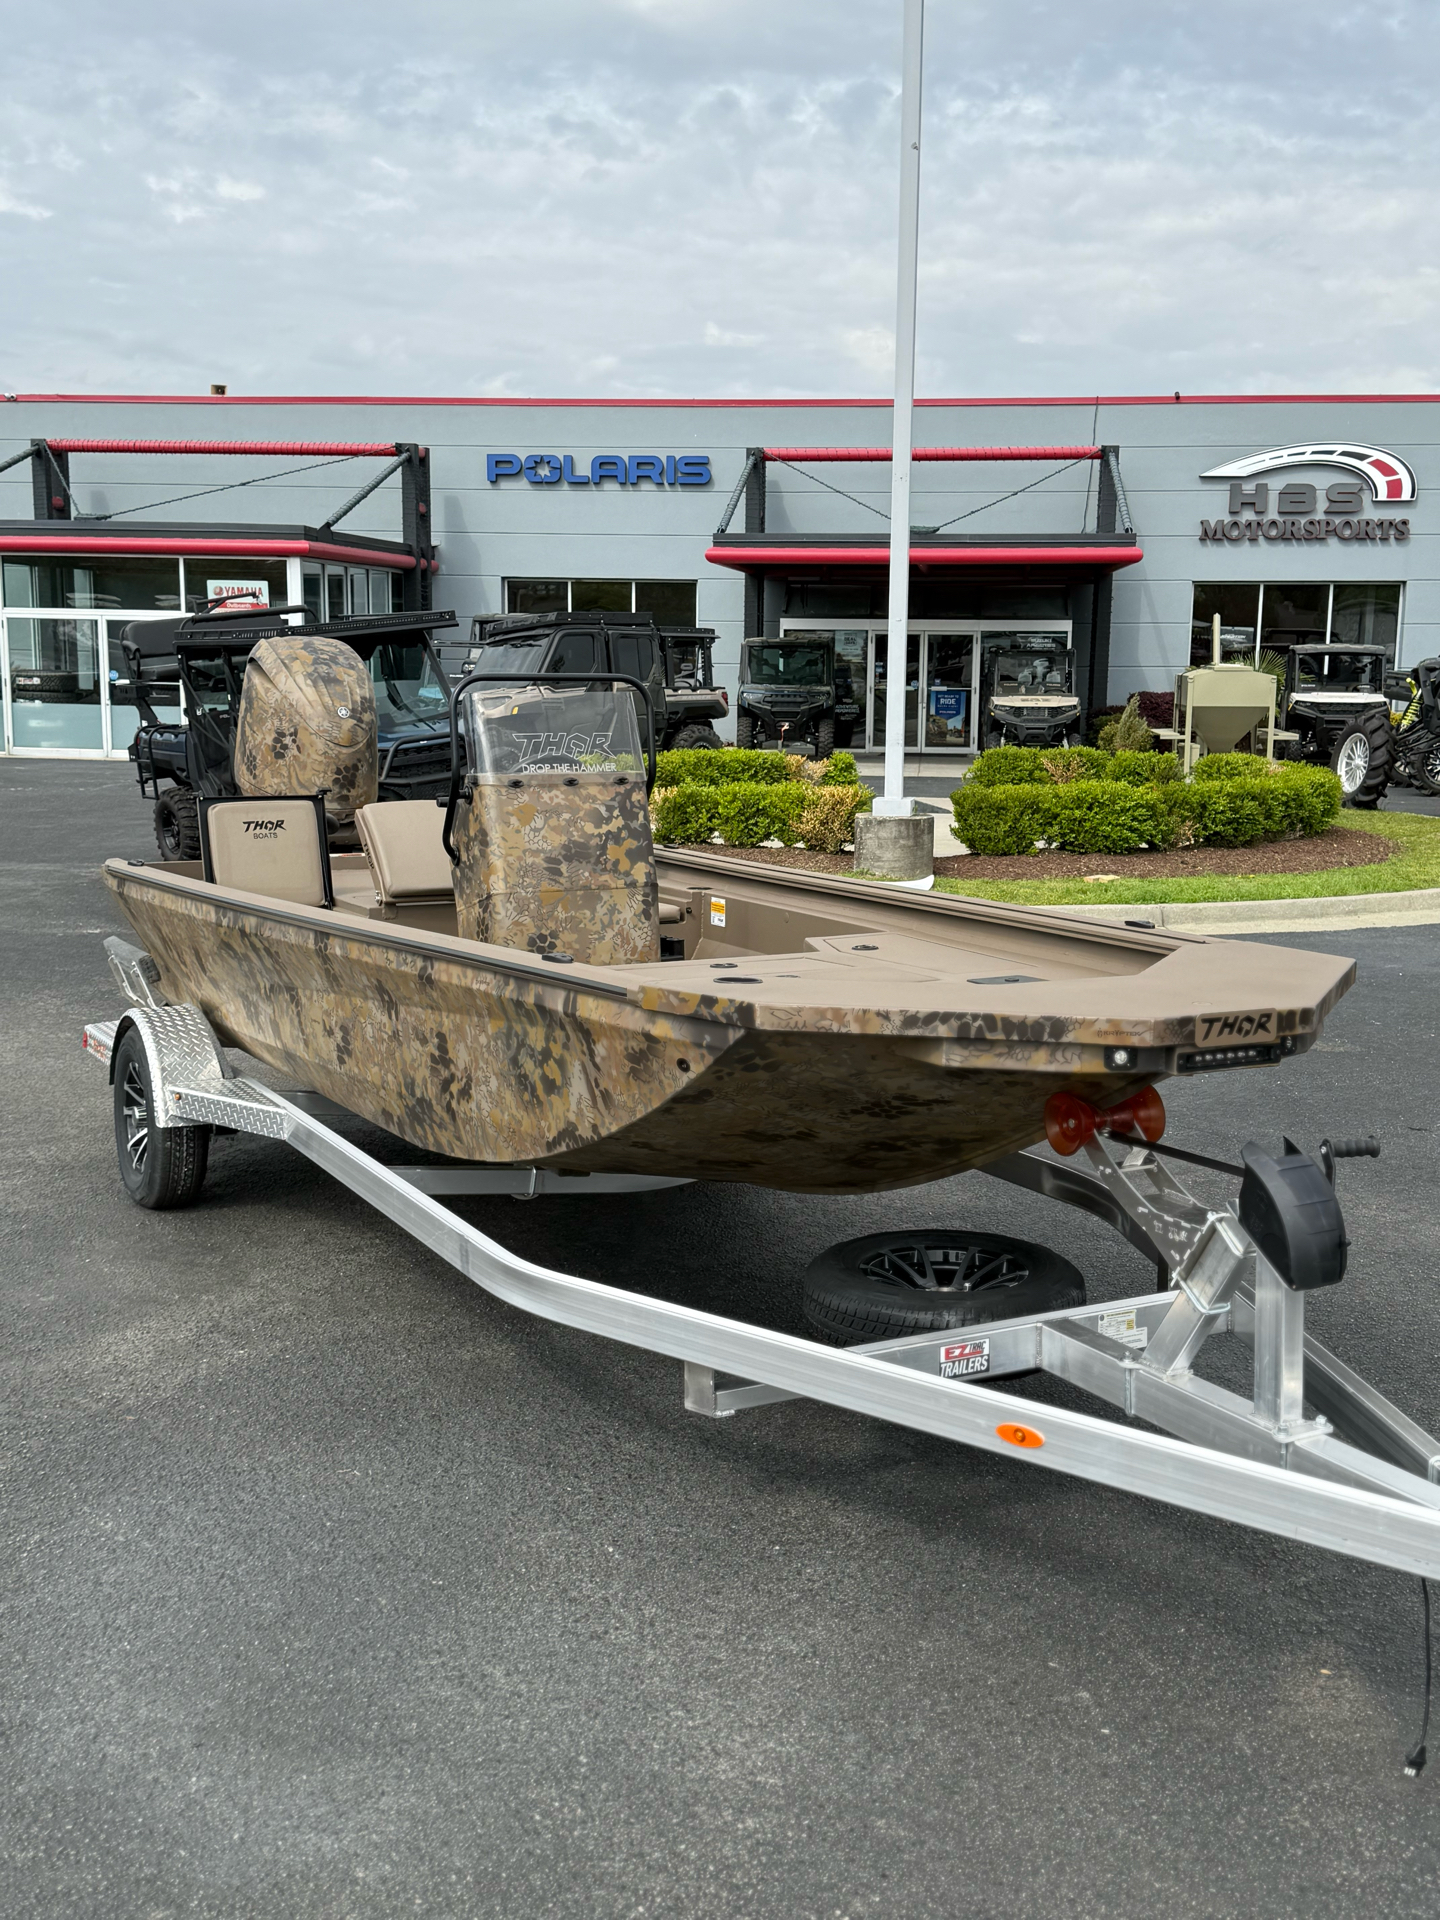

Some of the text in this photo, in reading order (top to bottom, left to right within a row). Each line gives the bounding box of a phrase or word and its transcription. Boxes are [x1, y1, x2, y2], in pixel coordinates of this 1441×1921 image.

[487, 454, 712, 485] POLARIS
[1229, 483, 1364, 513] HBS
[1200, 518, 1411, 541] MOTORSPORTS
[512, 733, 617, 762] THOR
[522, 762, 618, 774] DROP THE HAMMER
[242, 819, 287, 833] THOR
[253, 832, 278, 840] BOATS
[1201, 1012, 1273, 1042] THOR
[944, 1340, 987, 1361] EZ TRAC
[940, 1355, 989, 1378] TRAILERS
